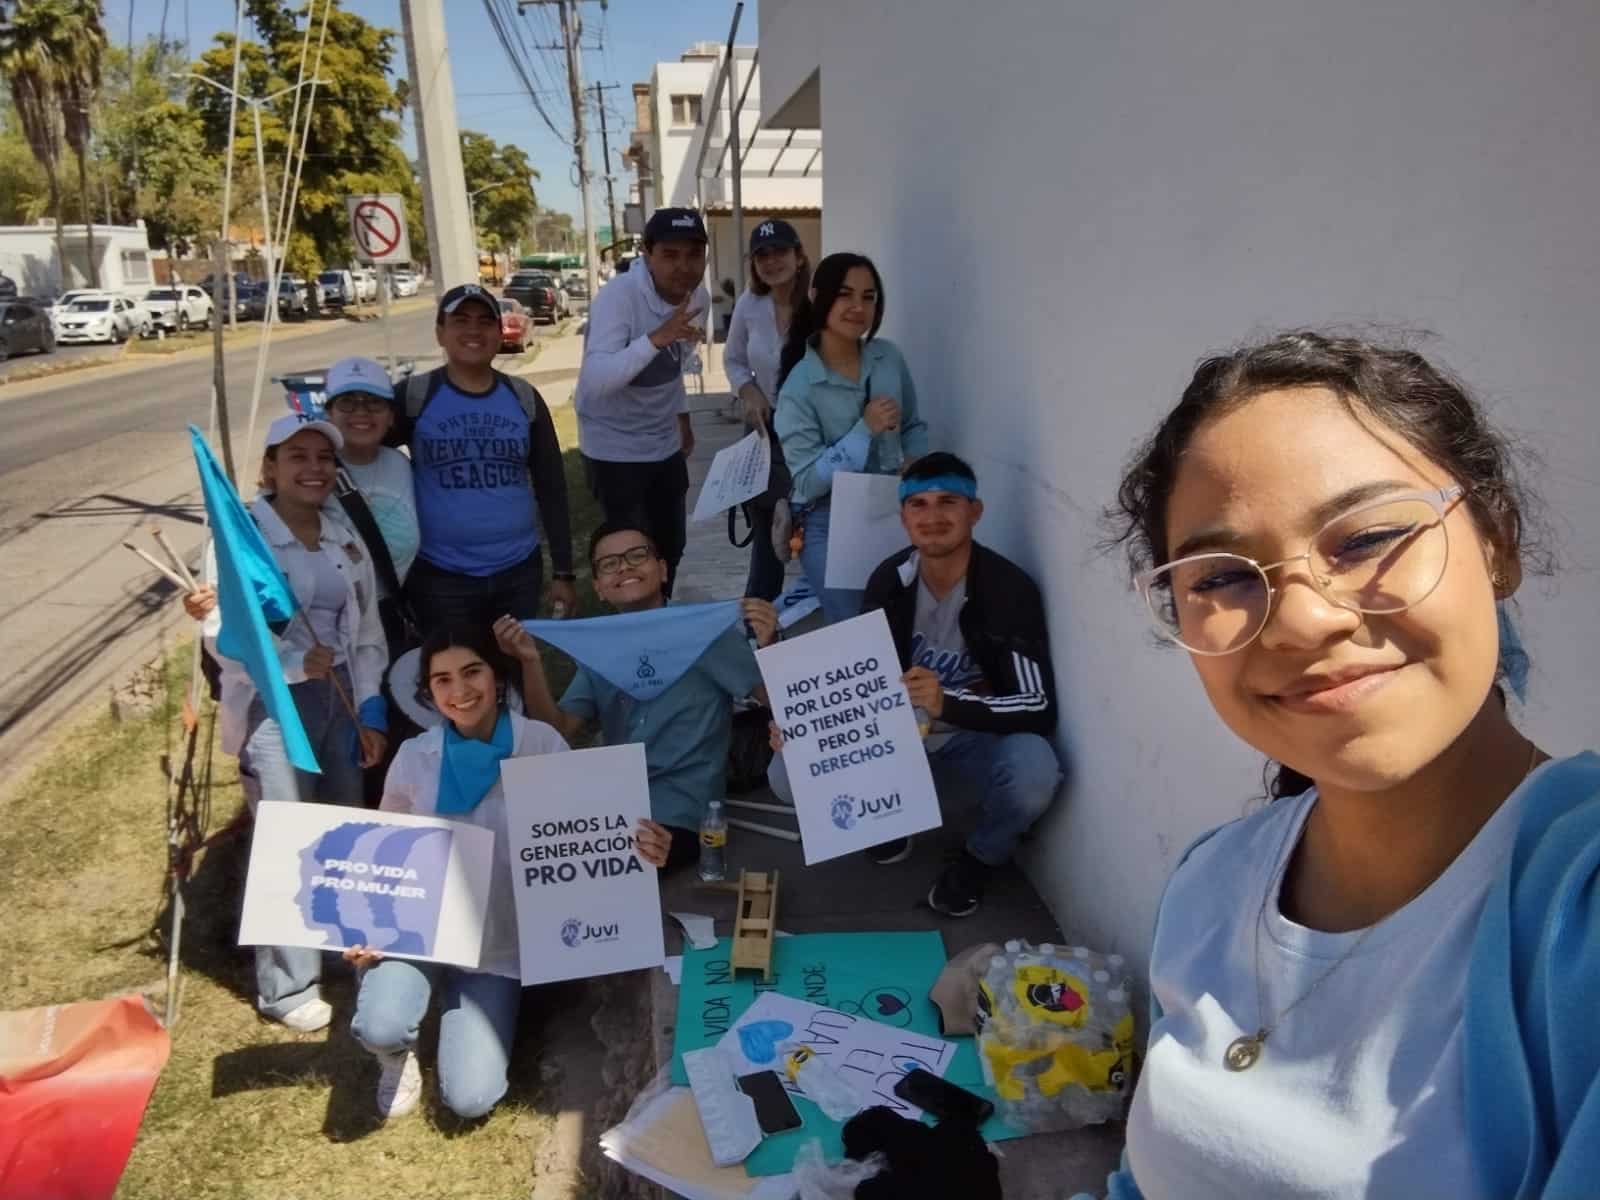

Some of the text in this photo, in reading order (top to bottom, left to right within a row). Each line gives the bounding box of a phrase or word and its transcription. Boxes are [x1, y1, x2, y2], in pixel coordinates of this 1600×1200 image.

[422, 437, 465, 461] NEW
[786, 657, 879, 698] HOY SALGO
[784, 675, 888, 720] POR LOS QUE
[782, 692, 905, 742] NO TIENEN VOZ
[818, 718, 880, 752] PERO SÍ
[809, 740, 896, 777] DERECHOS
[531, 814, 628, 839] SOMOS LA
[324, 858, 418, 881] PRO VIDA
[525, 855, 644, 888] PRO VIDA
[311, 875, 426, 899] PRO MUJER
[703, 960, 731, 985] NO
[703, 995, 732, 1037] VIDA
